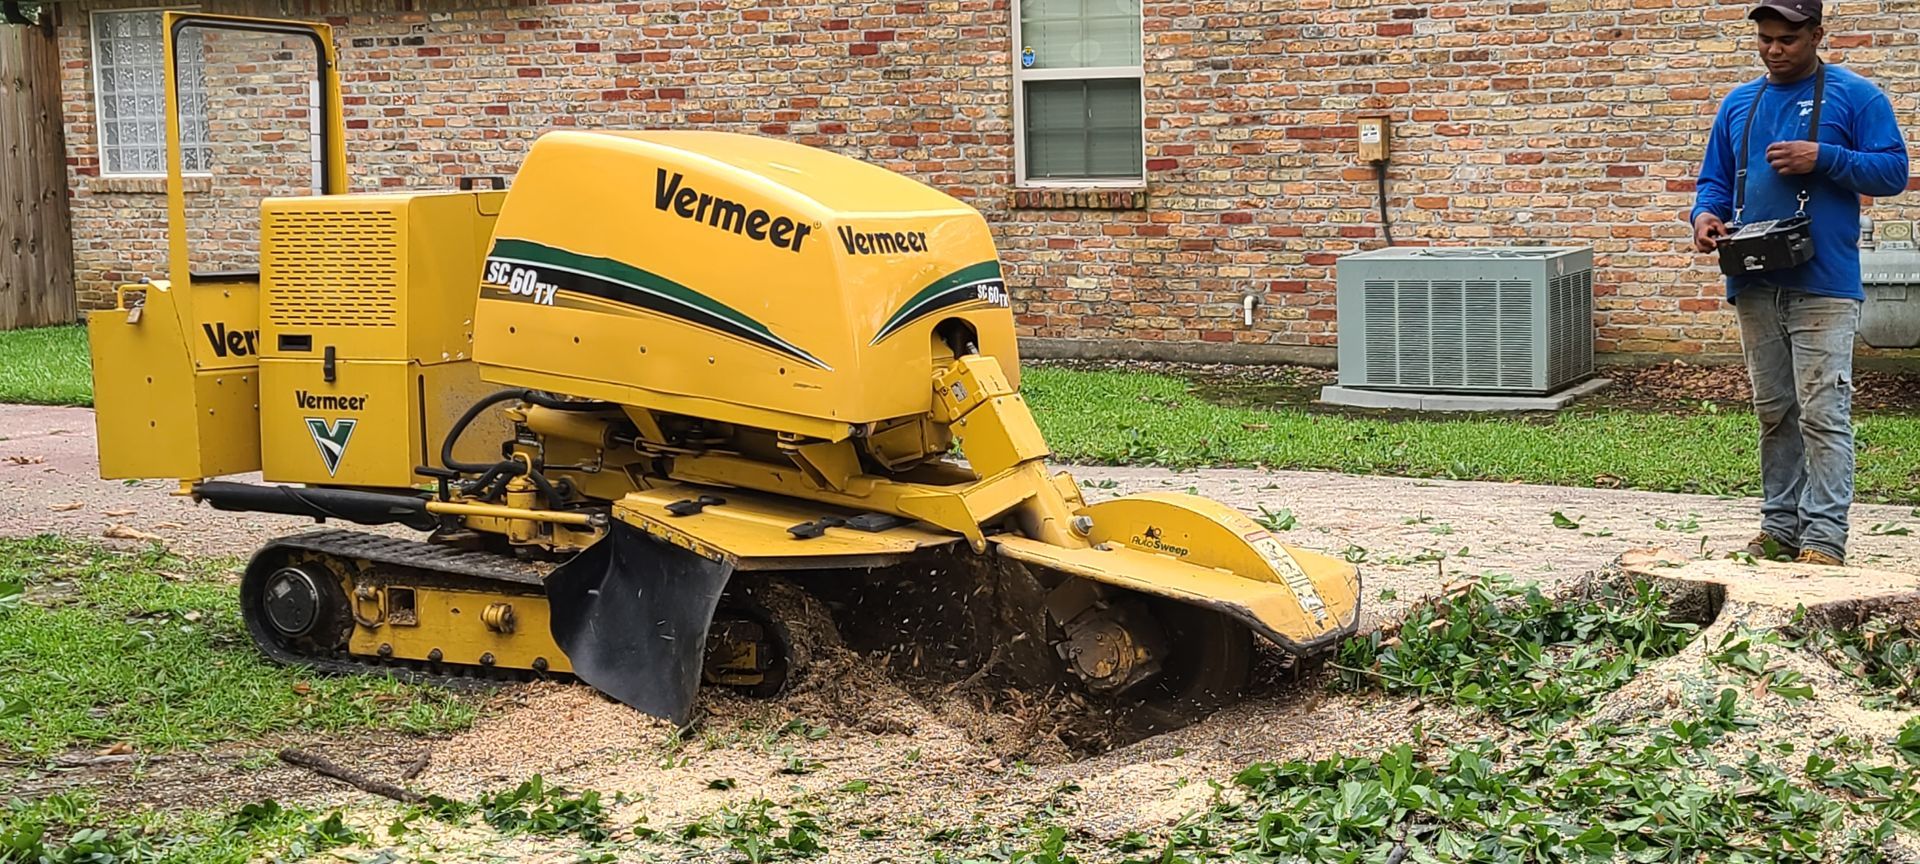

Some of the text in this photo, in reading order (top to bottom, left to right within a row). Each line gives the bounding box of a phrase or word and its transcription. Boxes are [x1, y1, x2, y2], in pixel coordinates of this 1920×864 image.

[655, 168, 811, 252] Vermeer
[838, 225, 928, 255] Vermeer
[202, 322, 259, 357] Ver
[295, 390, 366, 410] Vermeer
